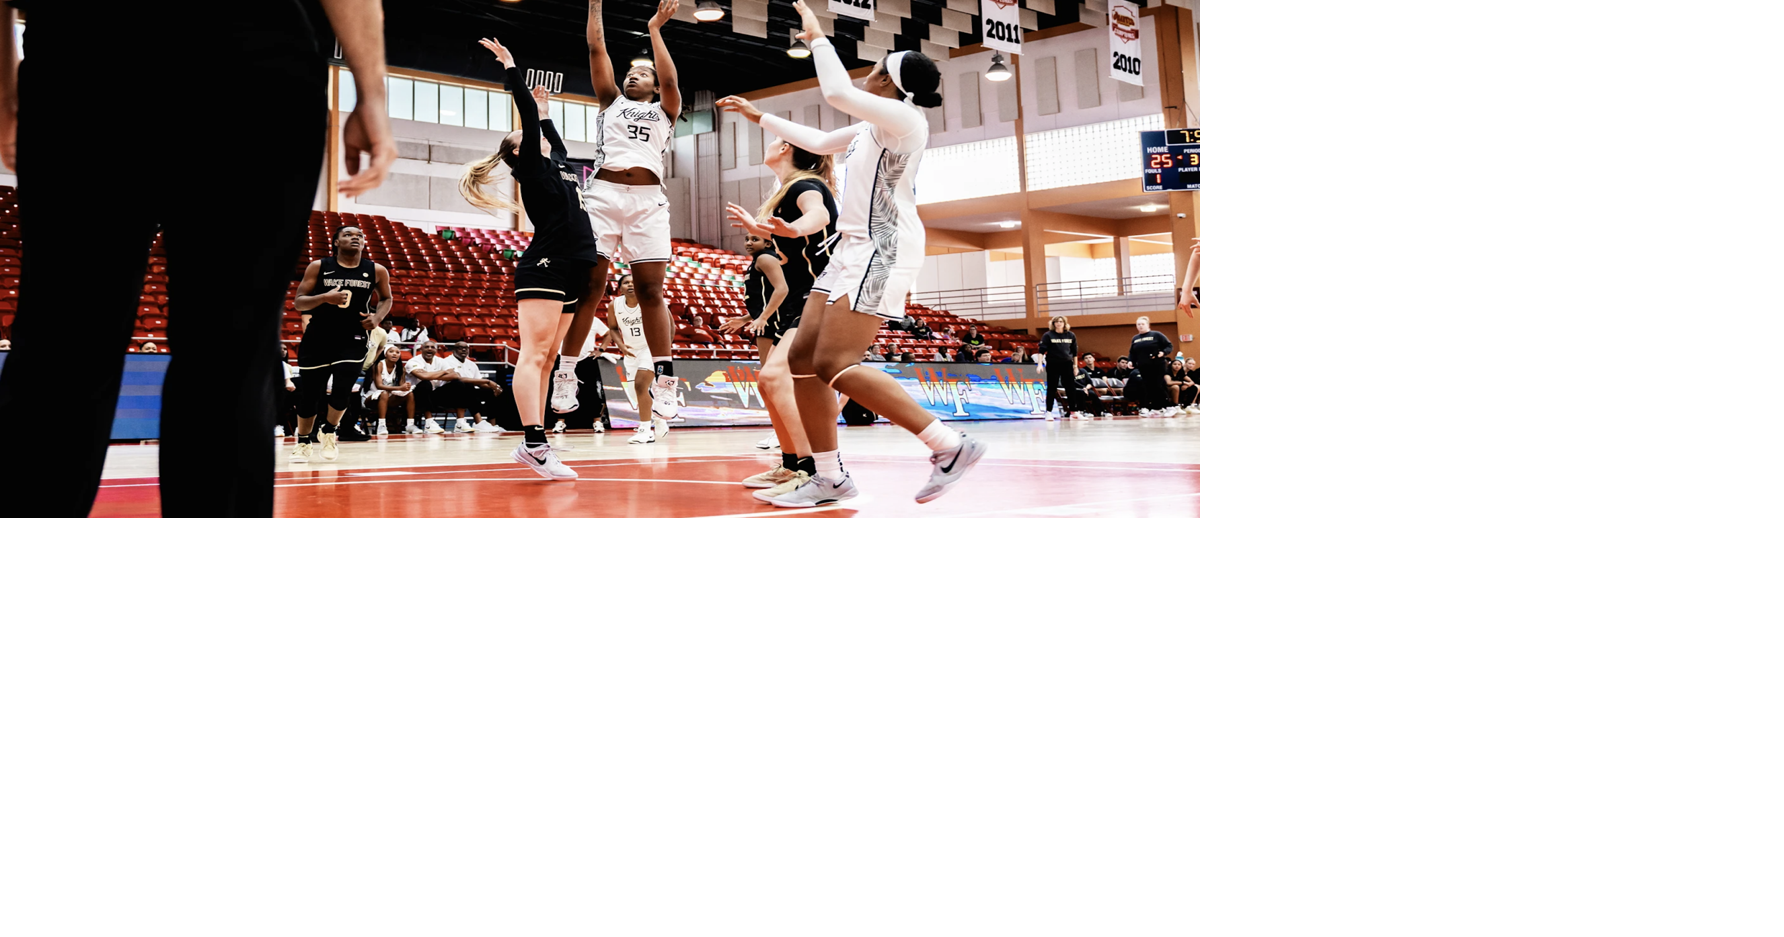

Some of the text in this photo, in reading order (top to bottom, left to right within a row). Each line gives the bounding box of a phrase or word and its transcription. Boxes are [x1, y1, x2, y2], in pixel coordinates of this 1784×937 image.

[986, 18, 1020, 44] 2011
[1113, 51, 1141, 75] 2010
[627, 125, 651, 142] 35
[1150, 154, 1173, 168] 25
[1190, 153, 1200, 165] 3
[629, 327, 641, 337] 13
[914, 367, 972, 417] WF
